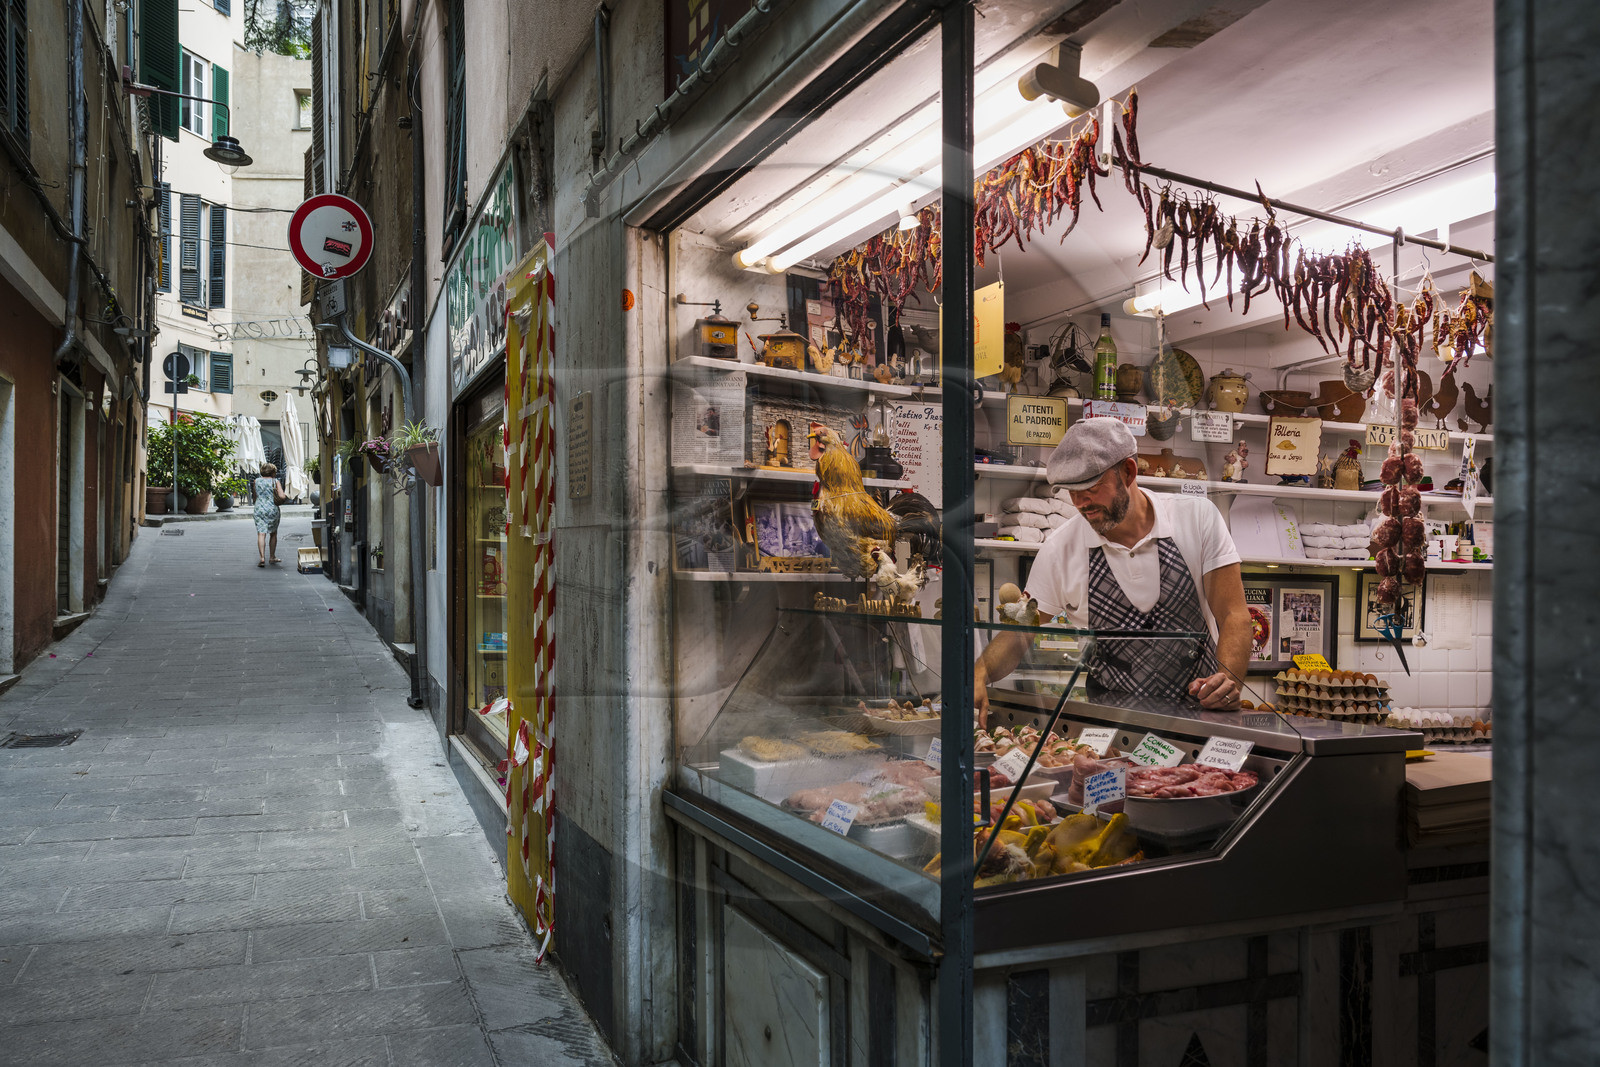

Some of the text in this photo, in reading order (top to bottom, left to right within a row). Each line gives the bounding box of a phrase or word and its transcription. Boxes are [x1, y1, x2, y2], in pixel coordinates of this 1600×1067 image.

[924, 408, 942, 420] Prez
[1022, 405, 1053, 414] ATTENTI
[1014, 415, 1062, 426] AL PADRONE
[1123, 417, 1144, 425] MATTI
[1274, 424, 1300, 437] Polleria
[1372, 426, 1420, 435] PLEE
[1370, 432, 1386, 443] NO
[1215, 741, 1241, 749] CONIGLIO
